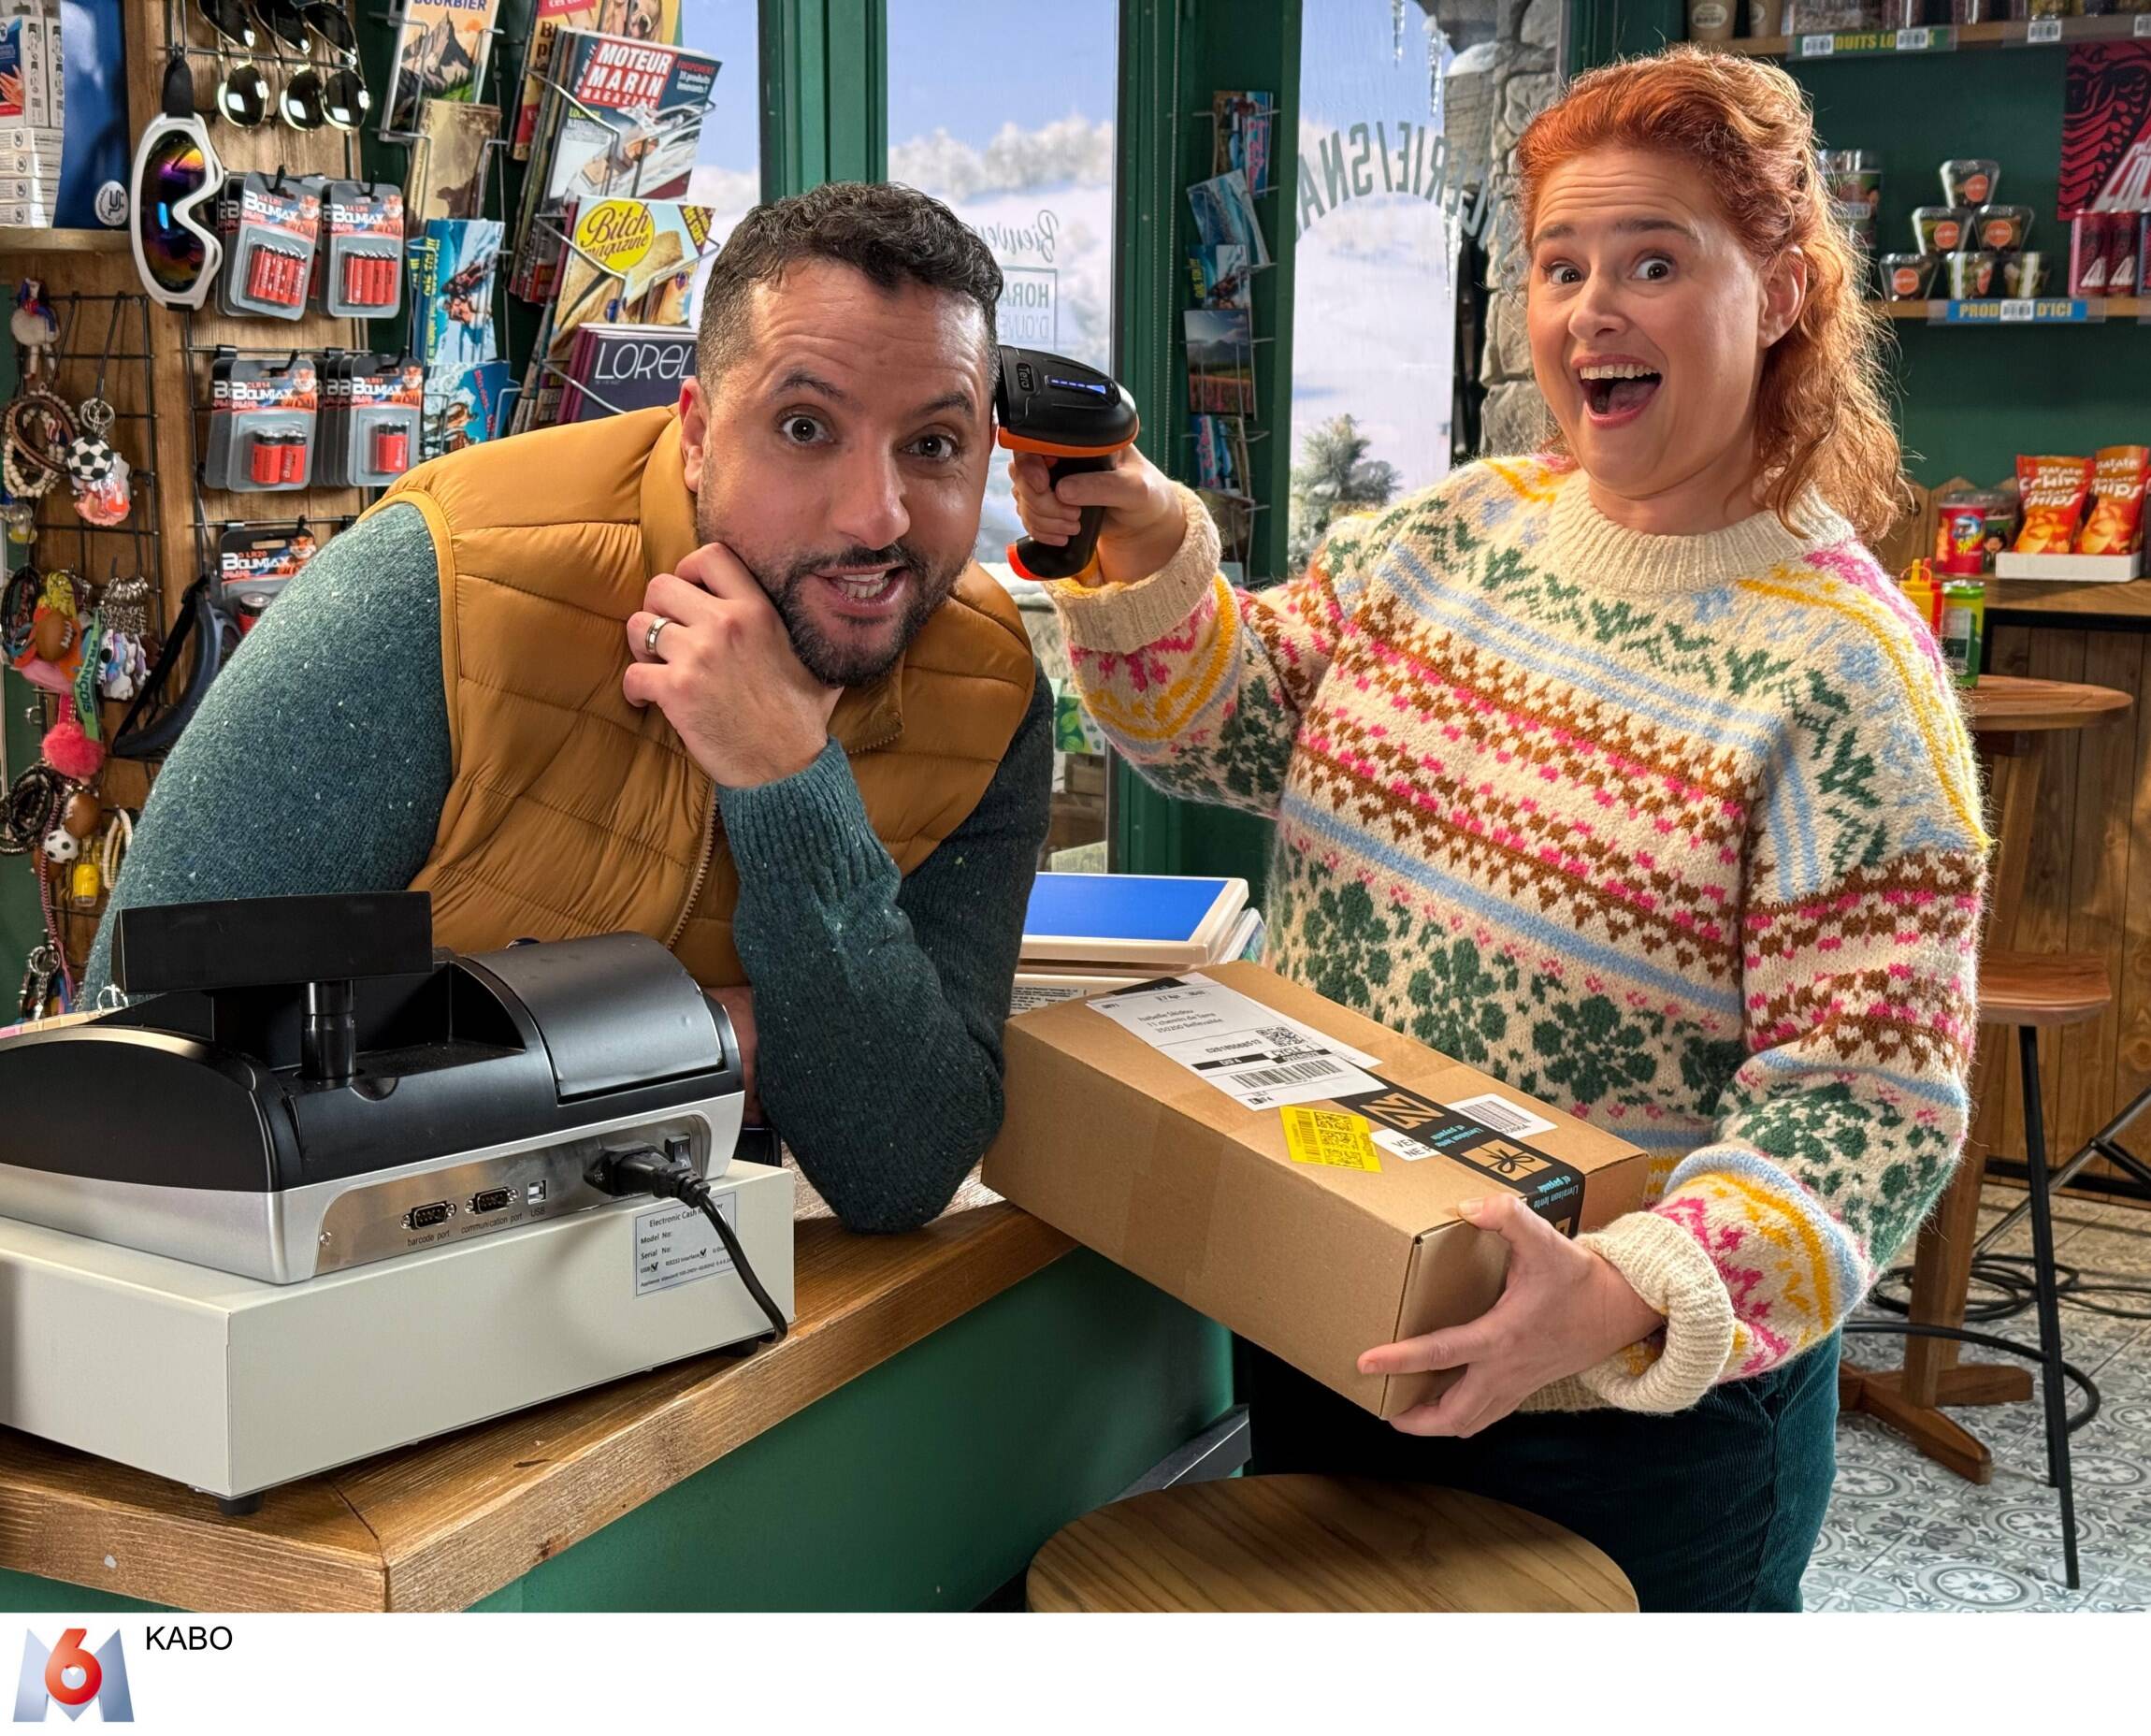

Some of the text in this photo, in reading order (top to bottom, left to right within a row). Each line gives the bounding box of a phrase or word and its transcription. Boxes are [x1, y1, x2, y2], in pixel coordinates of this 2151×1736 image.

[597, 43, 672, 75] MOTEUR
[587, 65, 664, 97] MARIN
[582, 88, 657, 109] MAGAZIE
[580, 203, 649, 248] Bitch
[1959, 302, 1999, 318] PROD
[76, 640, 97, 714] FRANÇOIS
[530, 1207, 546, 1217] USB
[649, 1212, 681, 1228] Electronic
[681, 1208, 698, 1220] Cash
[461, 1212, 524, 1234] communication port
[408, 1229, 450, 1247] barcode port
[641, 1233, 660, 1245] Model
[641, 1249, 657, 1260] Serial
